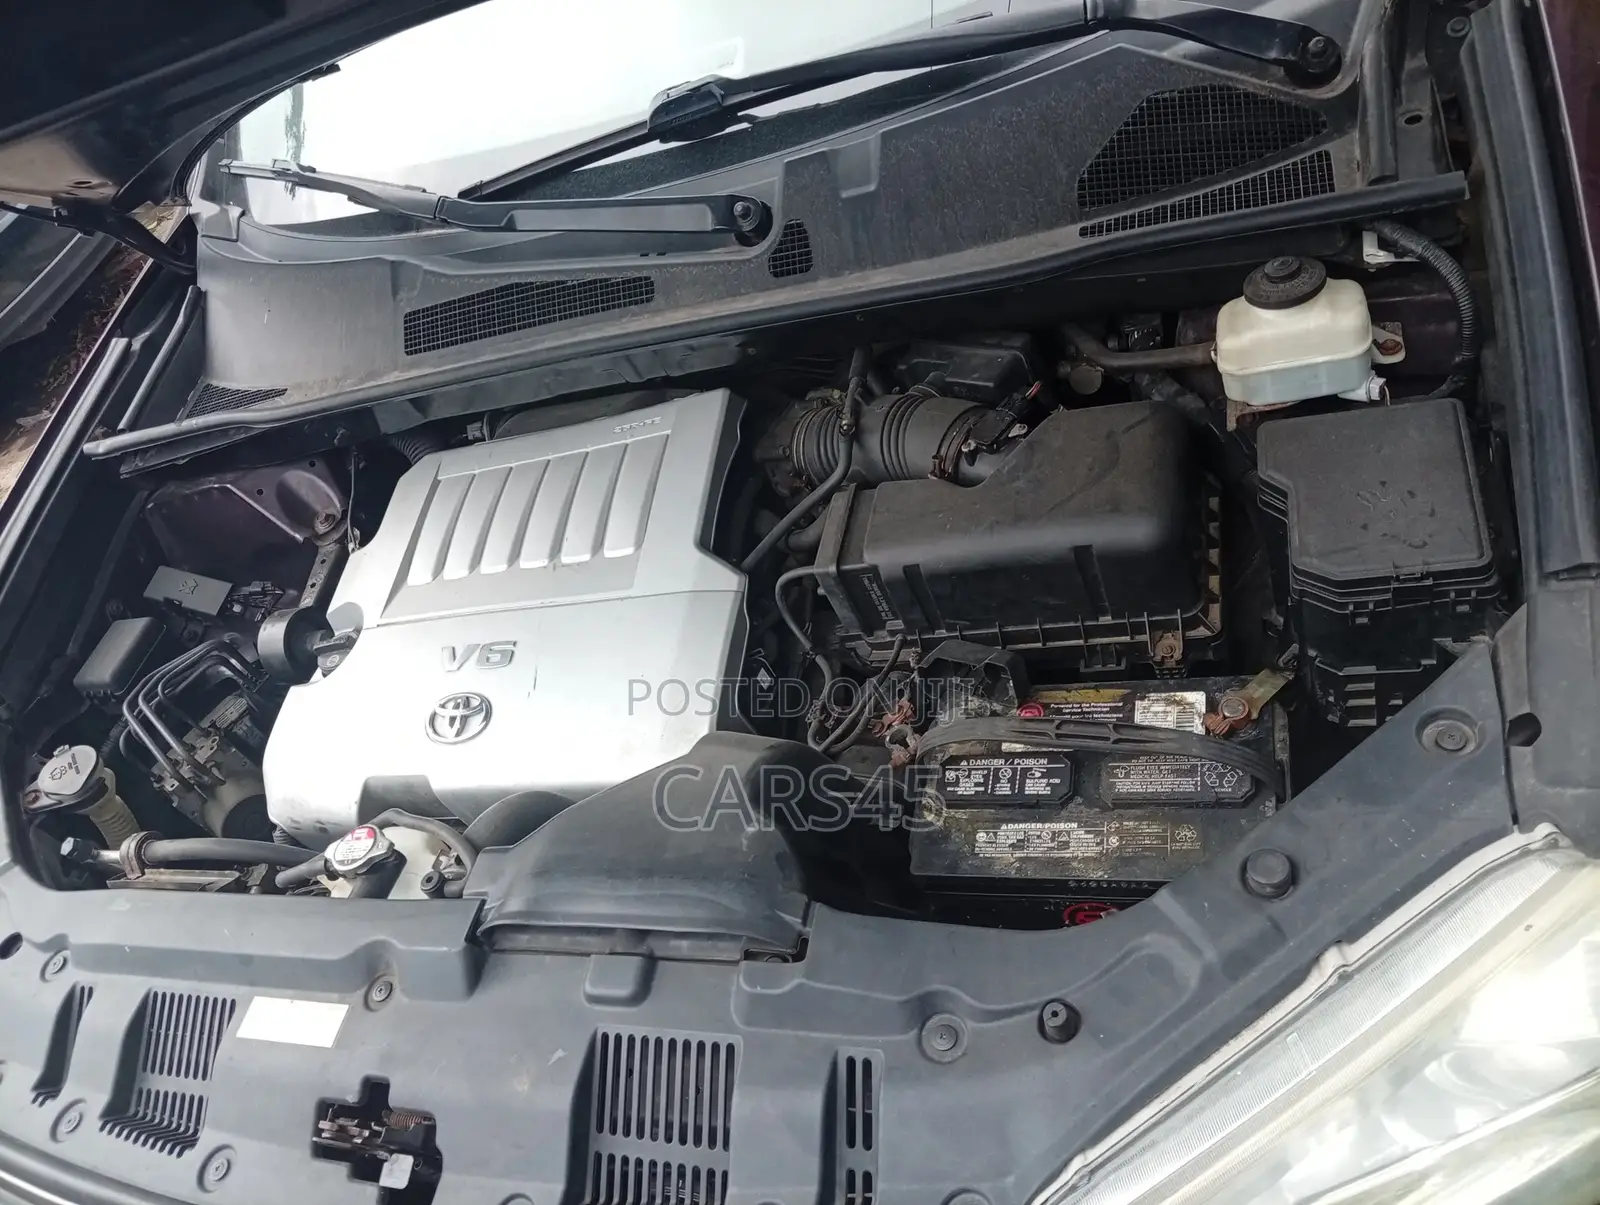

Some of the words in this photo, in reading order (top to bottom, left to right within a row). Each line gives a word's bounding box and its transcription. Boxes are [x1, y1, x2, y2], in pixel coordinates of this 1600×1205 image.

[441, 640, 518, 673] V6
[969, 758, 1006, 766] DANGER
[1014, 758, 1048, 766] POISON
